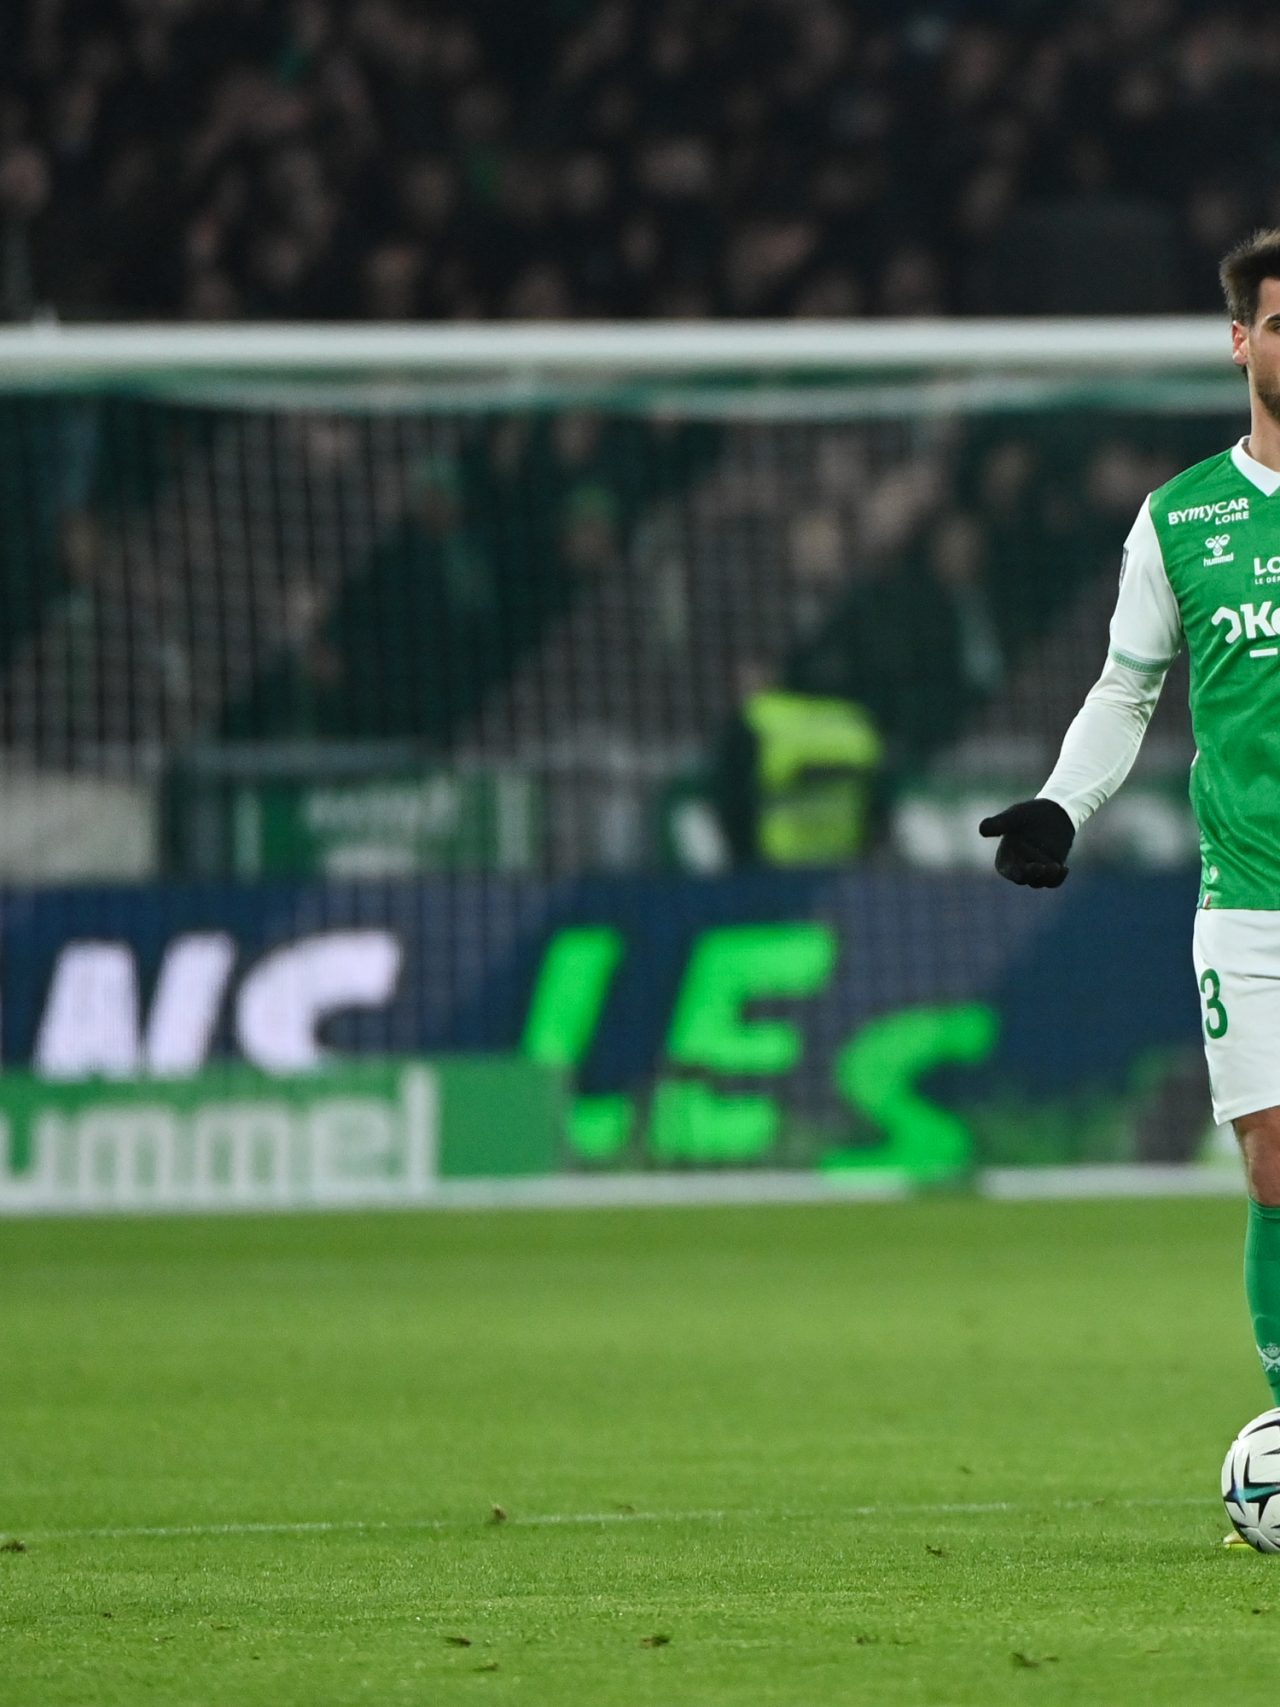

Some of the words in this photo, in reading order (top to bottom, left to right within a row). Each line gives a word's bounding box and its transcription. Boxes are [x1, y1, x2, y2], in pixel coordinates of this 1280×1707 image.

[1215, 511, 1249, 525] LOIRE
[1203, 552, 1234, 567] hummel
[1200, 968, 1228, 1039] 3
